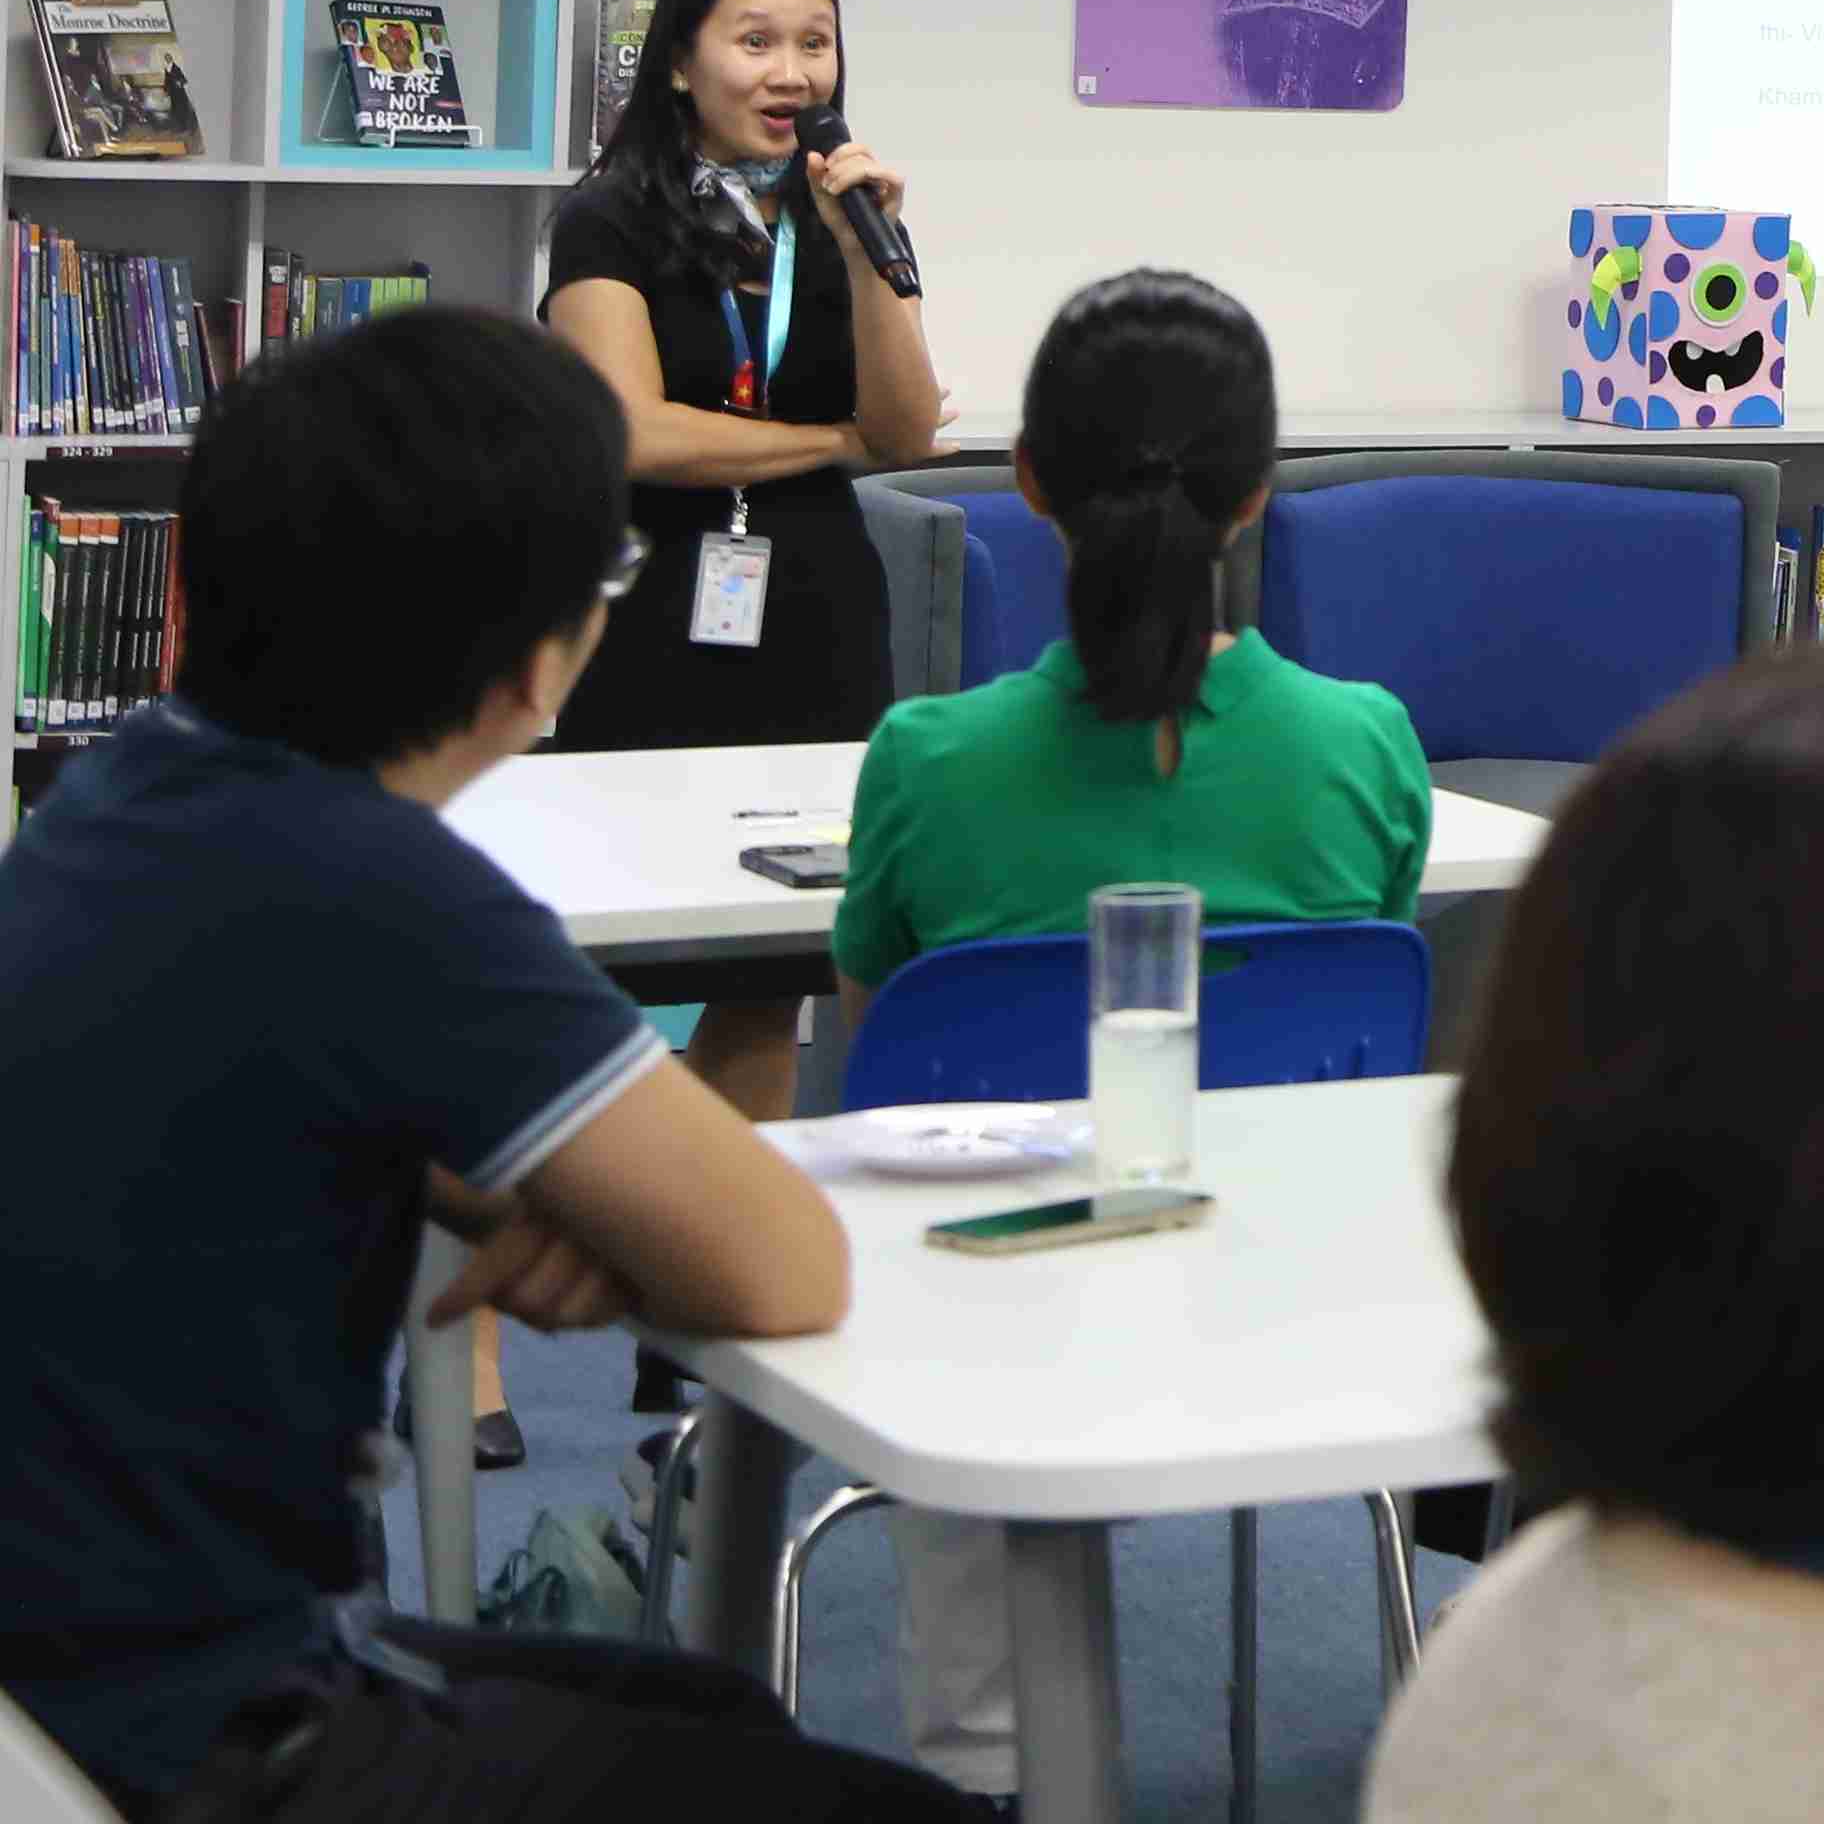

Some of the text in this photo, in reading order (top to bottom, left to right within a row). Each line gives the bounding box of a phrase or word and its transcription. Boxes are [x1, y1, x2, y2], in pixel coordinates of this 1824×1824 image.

[50, 14, 167, 29] Monroe Doctrine
[369, 72, 440, 94] WE ARE
[390, 94, 430, 112] NOT
[375, 112, 453, 132] BROKEN
[62, 446, 113, 457] 324 329
